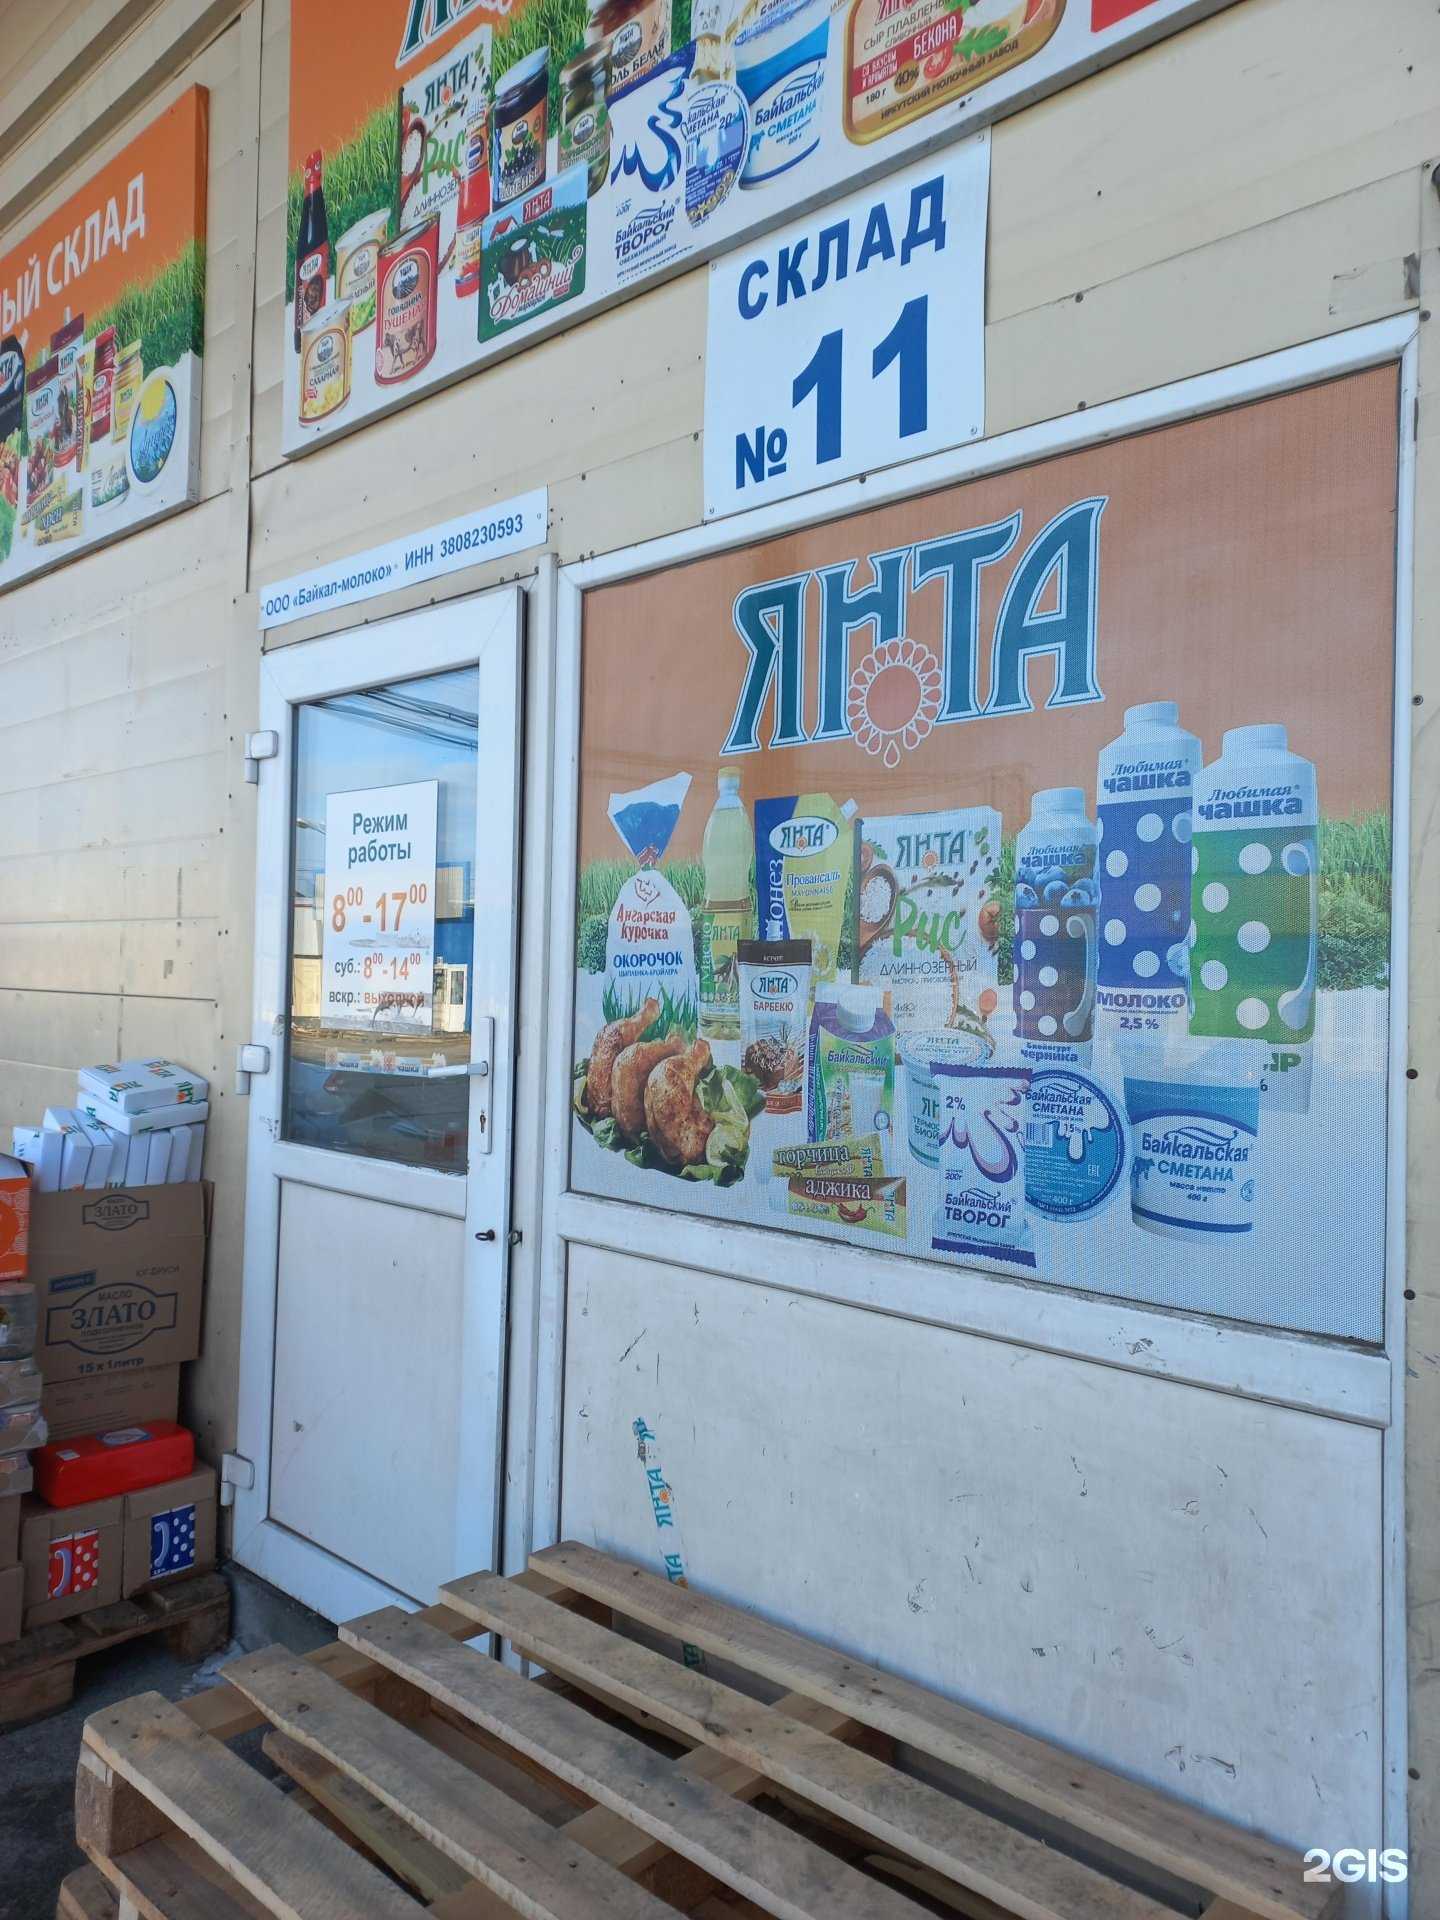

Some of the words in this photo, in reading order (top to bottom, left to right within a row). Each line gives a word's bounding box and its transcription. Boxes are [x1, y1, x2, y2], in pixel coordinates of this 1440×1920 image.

[863, 31, 885, 50] СЫР
[913, 15, 958, 60] БЕКОНА
[424, 54, 470, 116] ЯНТА
[755, 70, 825, 126] Байкальская
[865, 91, 881, 105] 180
[767, 98, 817, 137] СМЕТАНА
[615, 203, 675, 244] Байкальский
[614, 219, 674, 259] ТВОРОГ
[738, 174, 946, 321] СКЛАД
[0, 253, 40, 335] ЫЙ
[47, 172, 145, 296] СКЛАД
[736, 425, 788, 490] №
[792, 294, 928, 466] 11
[265, 594, 291, 617] ООО
[292, 564, 393, 607] «Байкал-молоко»
[404, 544, 434, 572] ИНН
[440, 513, 524, 559] 3808230593
[719, 495, 1109, 758] ЯНТА
[1111, 757, 1185, 778] Любимая
[1103, 769, 1192, 794] чашка
[1207, 783, 1292, 802] Любимая
[1198, 796, 1304, 821] чашка
[352, 811, 408, 836] Режим
[778, 822, 825, 850] ЯНТА
[348, 838, 411, 869] работы
[895, 830, 966, 869] ЯНТА
[1020, 849, 1087, 869] чашка
[786, 872, 841, 889] Провансаль
[616, 903, 676, 925] Ангарская
[712, 925, 740, 941] ЯНТА
[892, 895, 968, 958] Рис
[613, 951, 683, 968] ОКОРОЧОК
[880, 956, 977, 976] ДЛИННОЗЕРНЫЙ
[759, 977, 788, 993] ЯНТА
[753, 1000, 794, 1012] БАРБЕКЮ
[1120, 1016, 1143, 1030] 2,5
[1145, 1018, 1160, 1030] %
[828, 1050, 889, 1069] Байкальский
[945, 1095, 966, 1111] 2%
[1025, 1088, 1092, 1105] Байкальская
[1032, 1102, 1084, 1116] СМЕТАНА
[1142, 1131, 1250, 1162] Байкальская
[1157, 1159, 1235, 1181] СМЕТАНА
[805, 1179, 872, 1201] аджика
[94, 1203, 139, 1218] ЗЛАТО
[945, 1192, 1012, 1213] Байкальский
[945, 1206, 1011, 1229] ТВОРОГ
[71, 1299, 156, 1330] ЗЛАТО
[646, 1465, 674, 1528] ЯНТА
